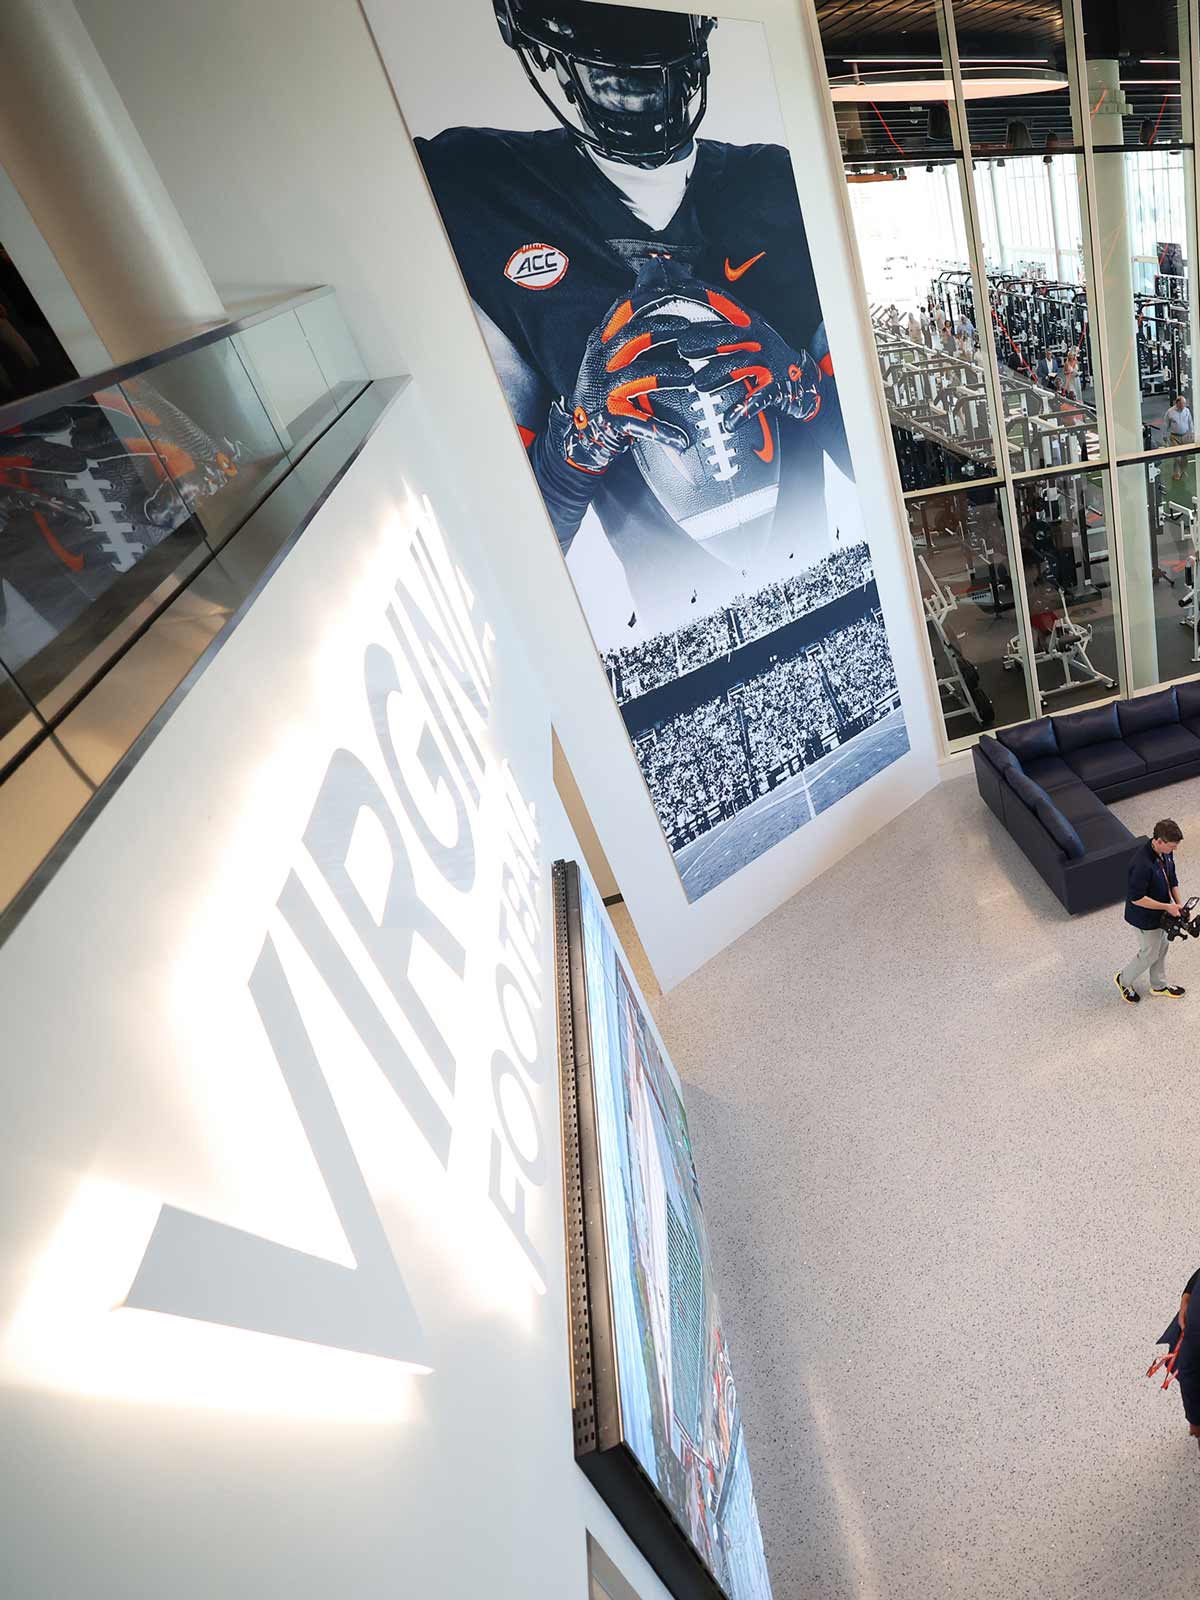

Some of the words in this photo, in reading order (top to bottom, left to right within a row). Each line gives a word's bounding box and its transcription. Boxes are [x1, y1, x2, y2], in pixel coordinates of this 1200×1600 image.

[516, 252, 557, 275] ACC
[122, 495, 502, 1372] VIRGINIA
[488, 760, 547, 1296] FOOTBALL
